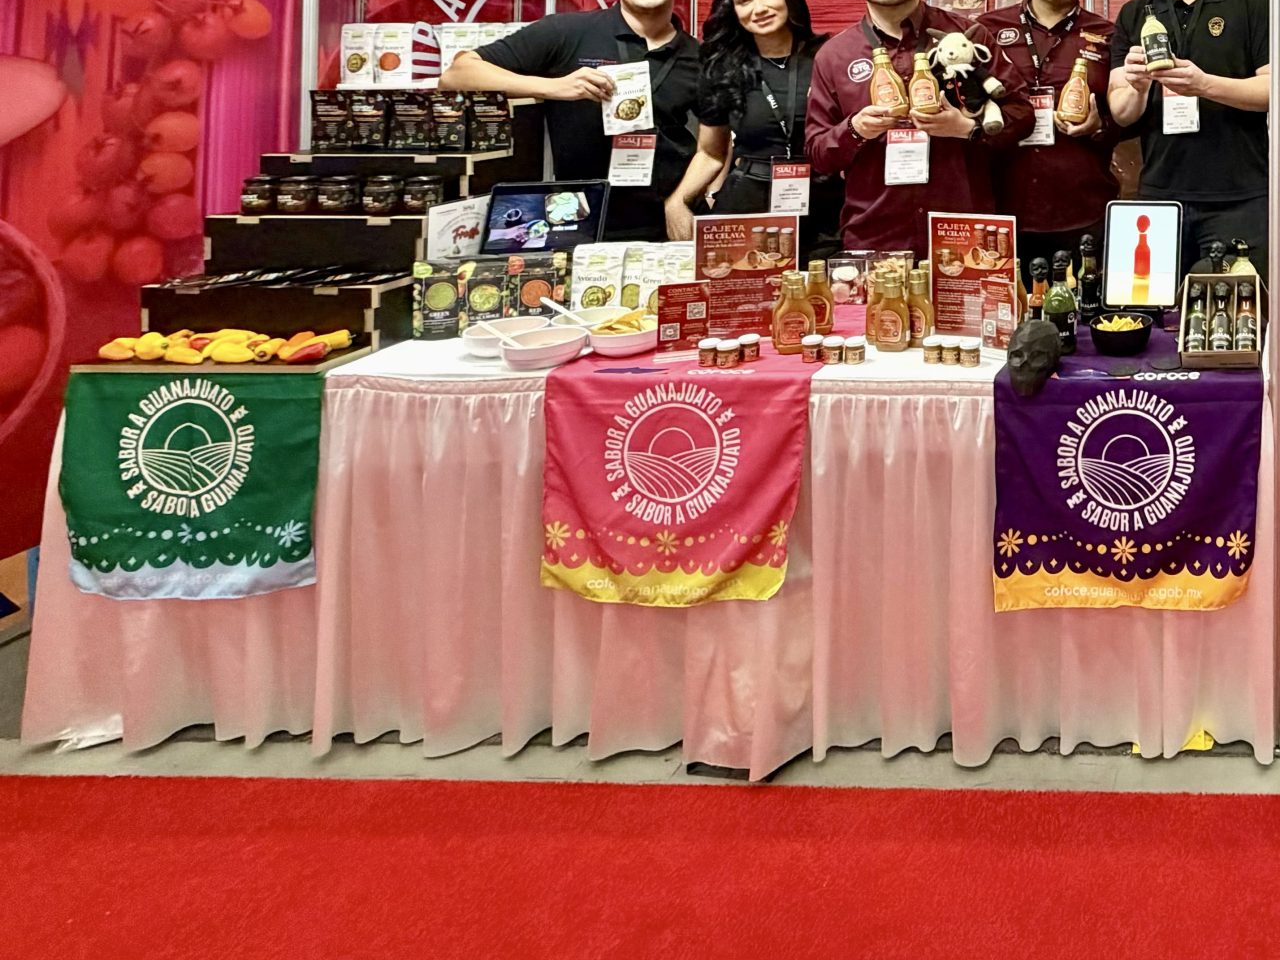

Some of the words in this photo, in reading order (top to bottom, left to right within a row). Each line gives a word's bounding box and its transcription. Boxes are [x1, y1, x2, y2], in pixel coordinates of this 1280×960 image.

[703, 224, 746, 233] CAJETA
[715, 232, 746, 240] CELAYA
[937, 223, 971, 231] CAJETA
[138, 378, 236, 416] GUANAJUATO
[624, 382, 723, 417] GUANAJUATO
[1076, 388, 1175, 423] GUANAJUATO
[128, 412, 147, 428] A
[613, 415, 631, 432] A
[1066, 420, 1085, 438] A
[118, 426, 141, 481] SABOR
[189, 499, 200, 518] A
[200, 424, 255, 514] GUANAJUATO
[604, 427, 626, 482] SABOR
[1056, 433, 1080, 489] SABOR
[625, 493, 672, 526] SABOR
[675, 506, 686, 525] A
[685, 427, 742, 520] GUANAJUATO
[1081, 500, 1130, 532] SABOR
[1133, 512, 1144, 531] A
[1143, 435, 1196, 526] GUANAJUATO
